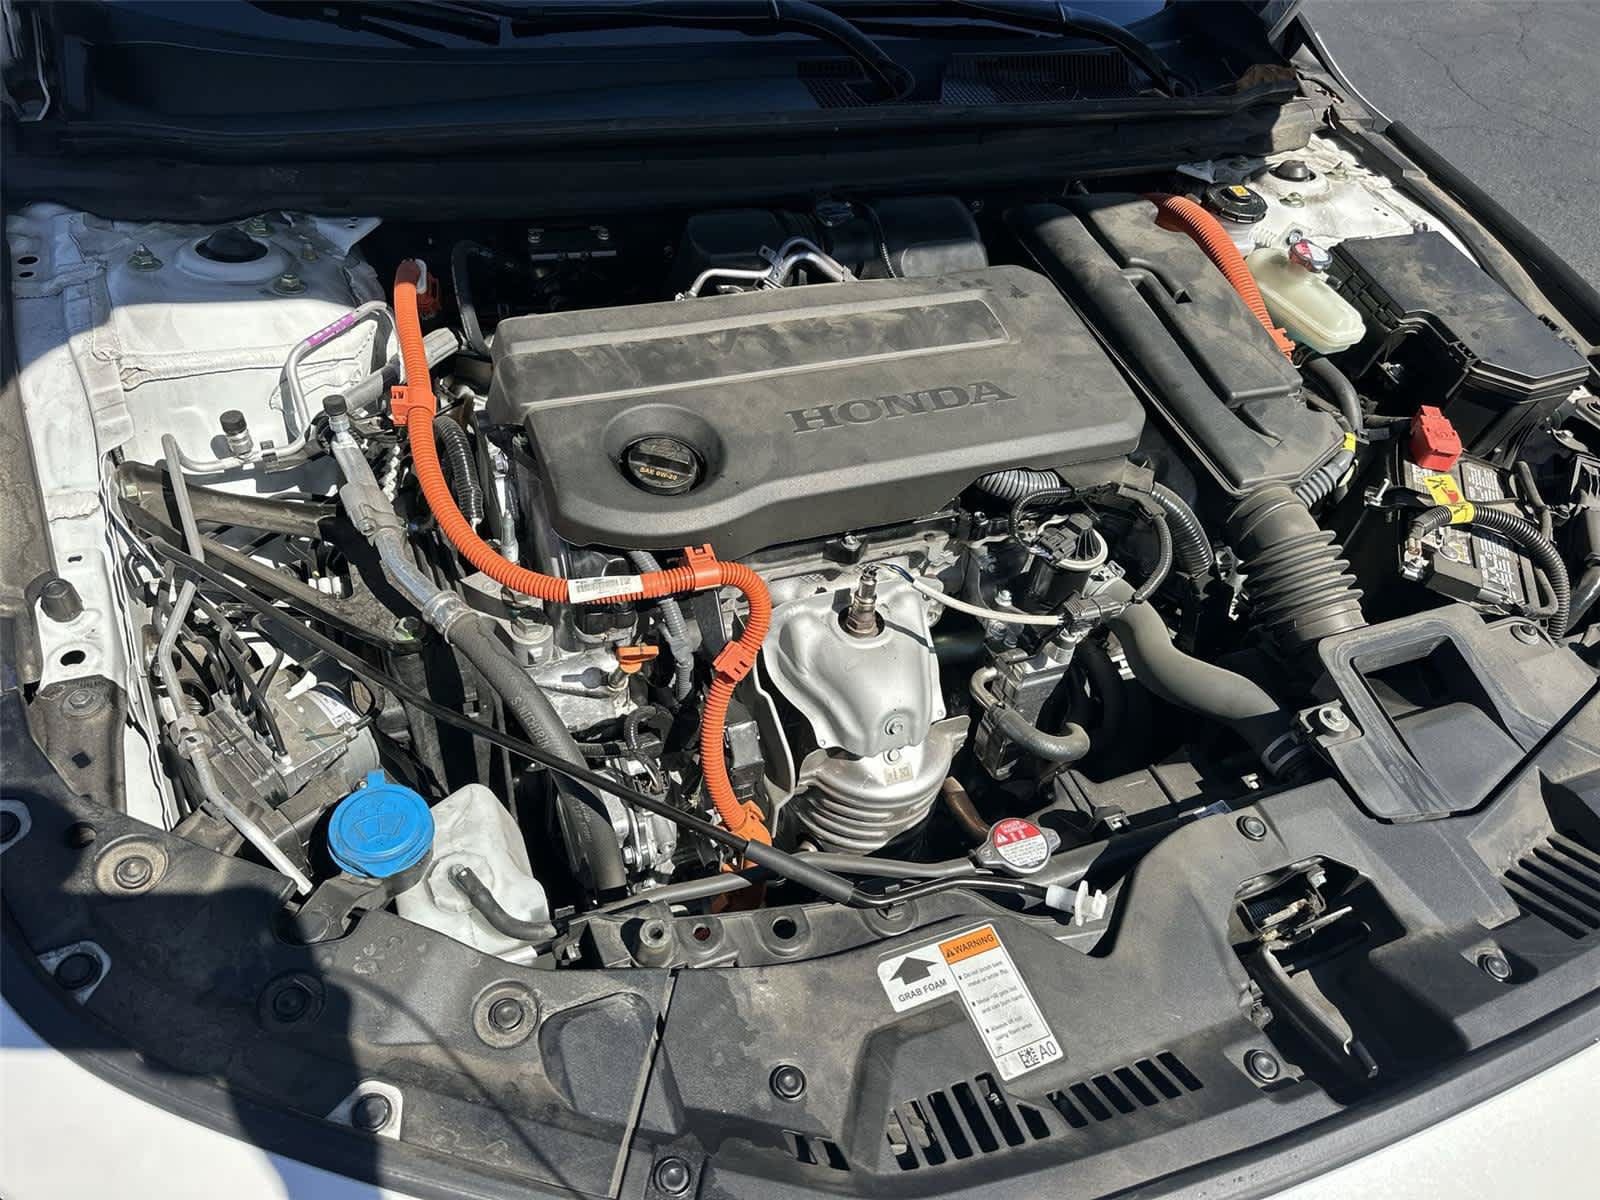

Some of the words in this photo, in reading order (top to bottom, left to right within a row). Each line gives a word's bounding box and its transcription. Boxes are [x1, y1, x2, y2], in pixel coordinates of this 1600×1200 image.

[784, 381, 1017, 433] HONDA
[953, 934, 994, 955] WARNING
[898, 987, 923, 1002] GRAB
[923, 978, 947, 994] FOAM
